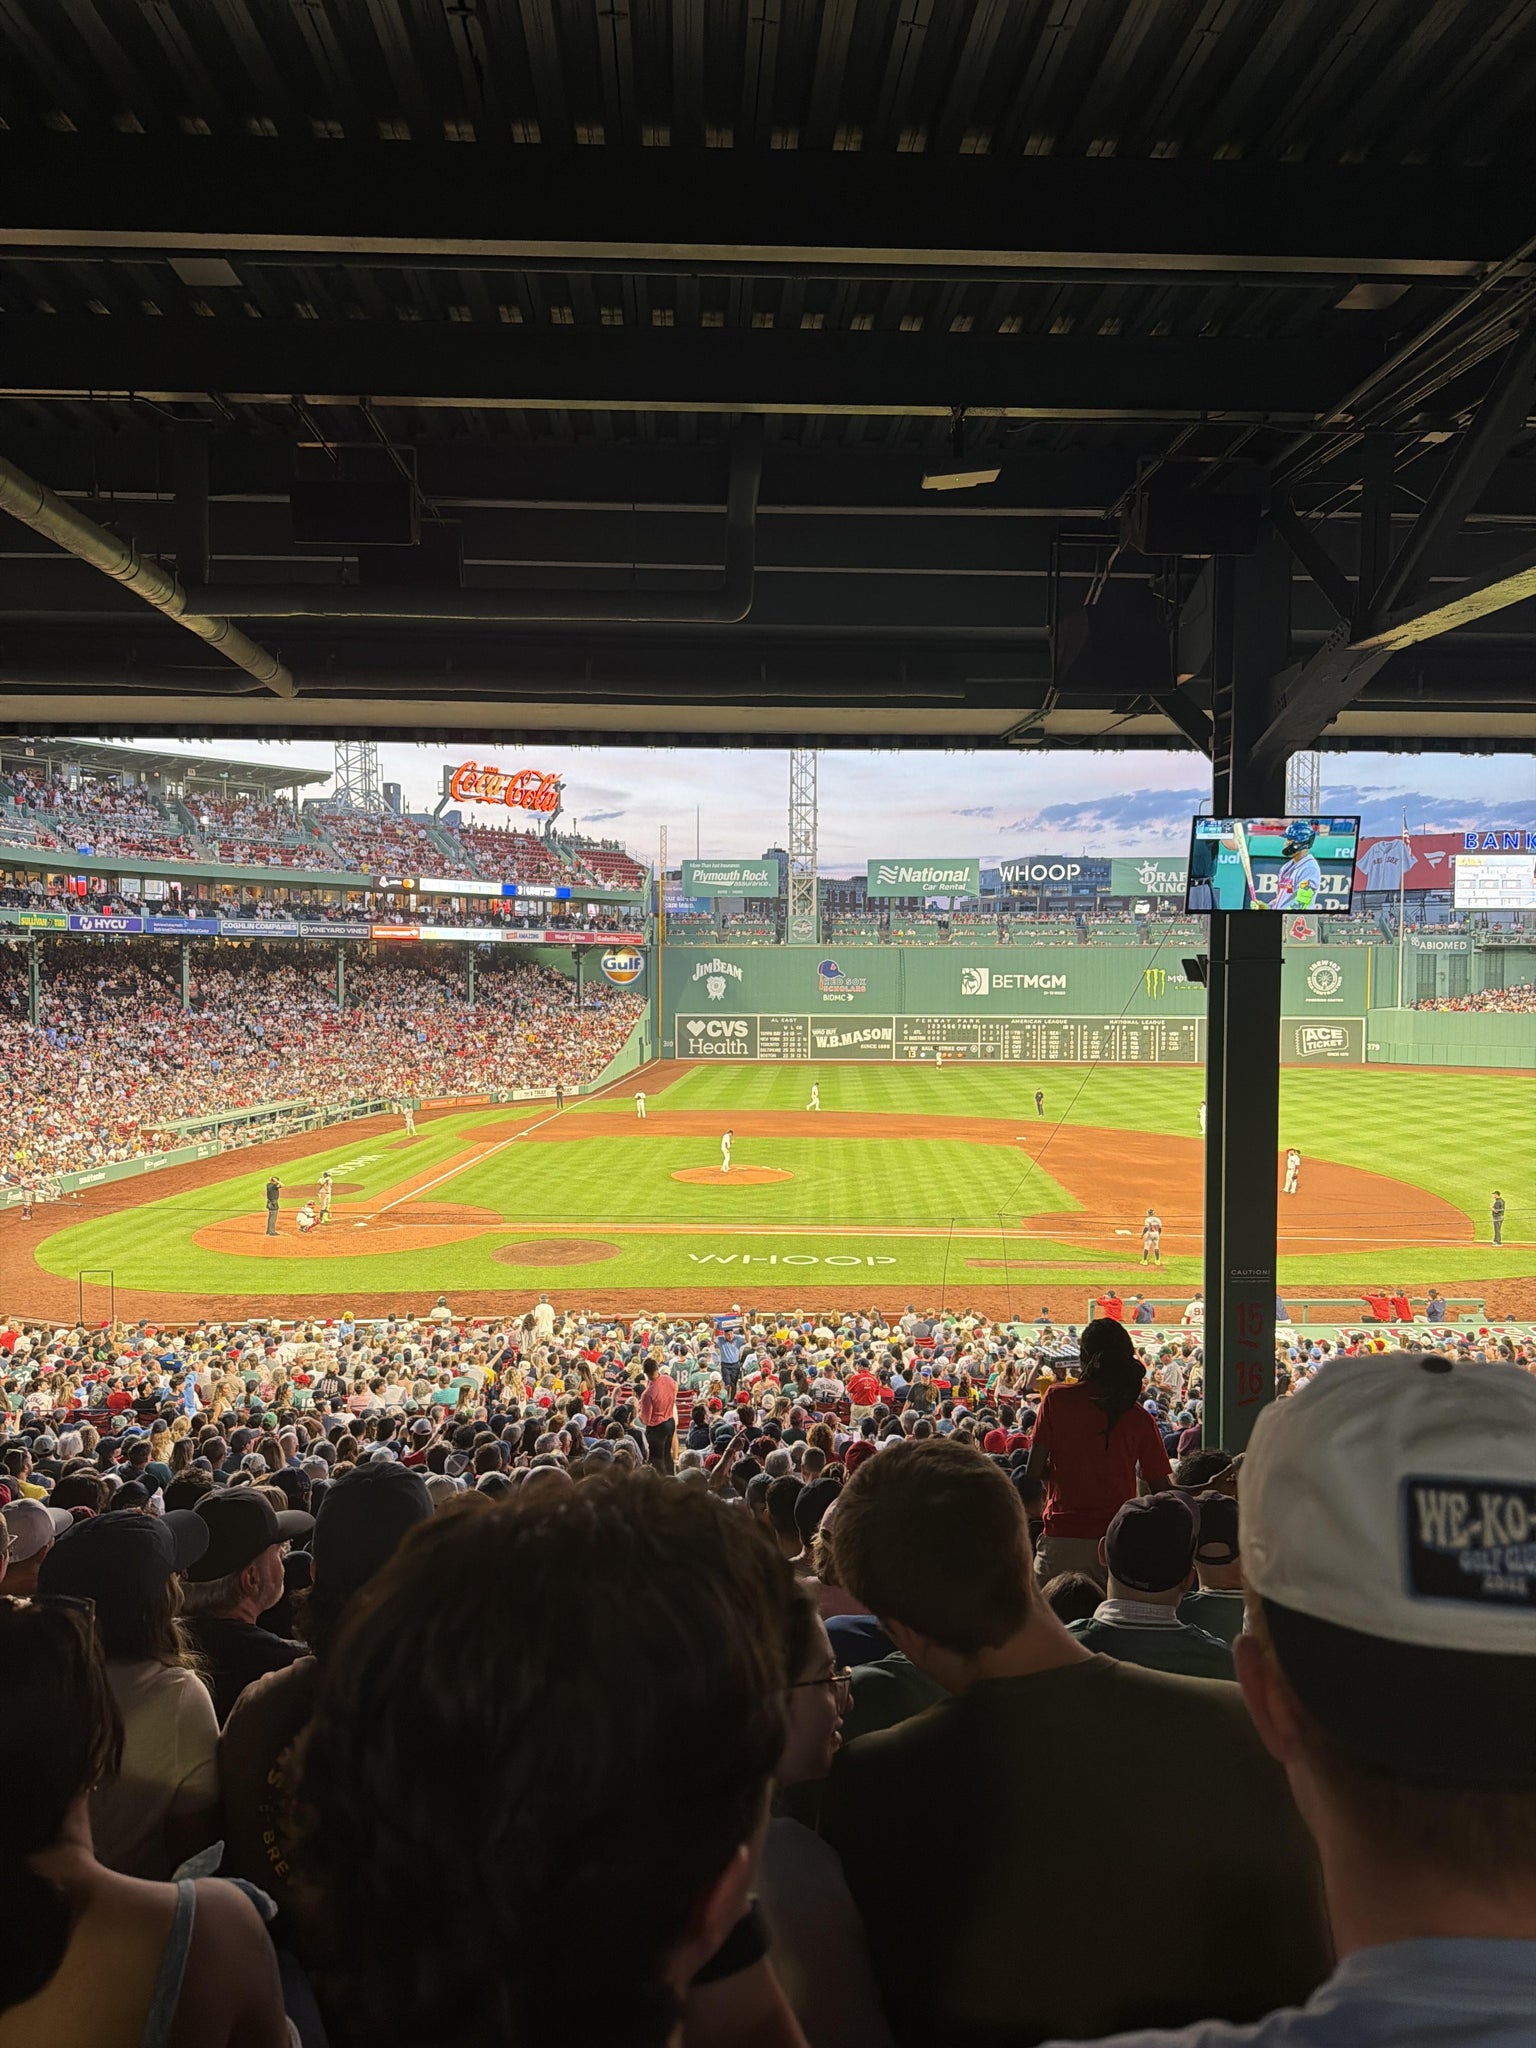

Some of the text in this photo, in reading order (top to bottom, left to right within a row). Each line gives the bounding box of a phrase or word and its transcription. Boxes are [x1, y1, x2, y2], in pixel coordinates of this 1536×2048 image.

[692, 869, 768, 884] Plymouth Rock
[999, 864, 1080, 882] WHOOP
[1140, 871, 1187, 885] DRAF
[922, 883, 966, 891] Car Rental
[1146, 882, 1187, 893] KING
[94, 918, 126, 929] HYCU
[223, 922, 297, 931] COGHLIN COMPANIES
[346, 927, 368, 935] VINES
[1419, 941, 1467, 950] ABIOMED
[603, 956, 641, 972] Gulf
[992, 974, 1066, 988] BETMGM
[706, 1020, 749, 1037] CVS
[1306, 1028, 1343, 1041] ACE
[688, 1038, 749, 1055] Health
[1307, 1039, 1343, 1050] TICKET
[688, 1253, 897, 1266] WHOOP
[1237, 1303, 1263, 1337] 15
[15, 1370, 30, 1384] 52
[676, 1369, 688, 1384] 18
[1237, 1361, 1263, 1396] 16
